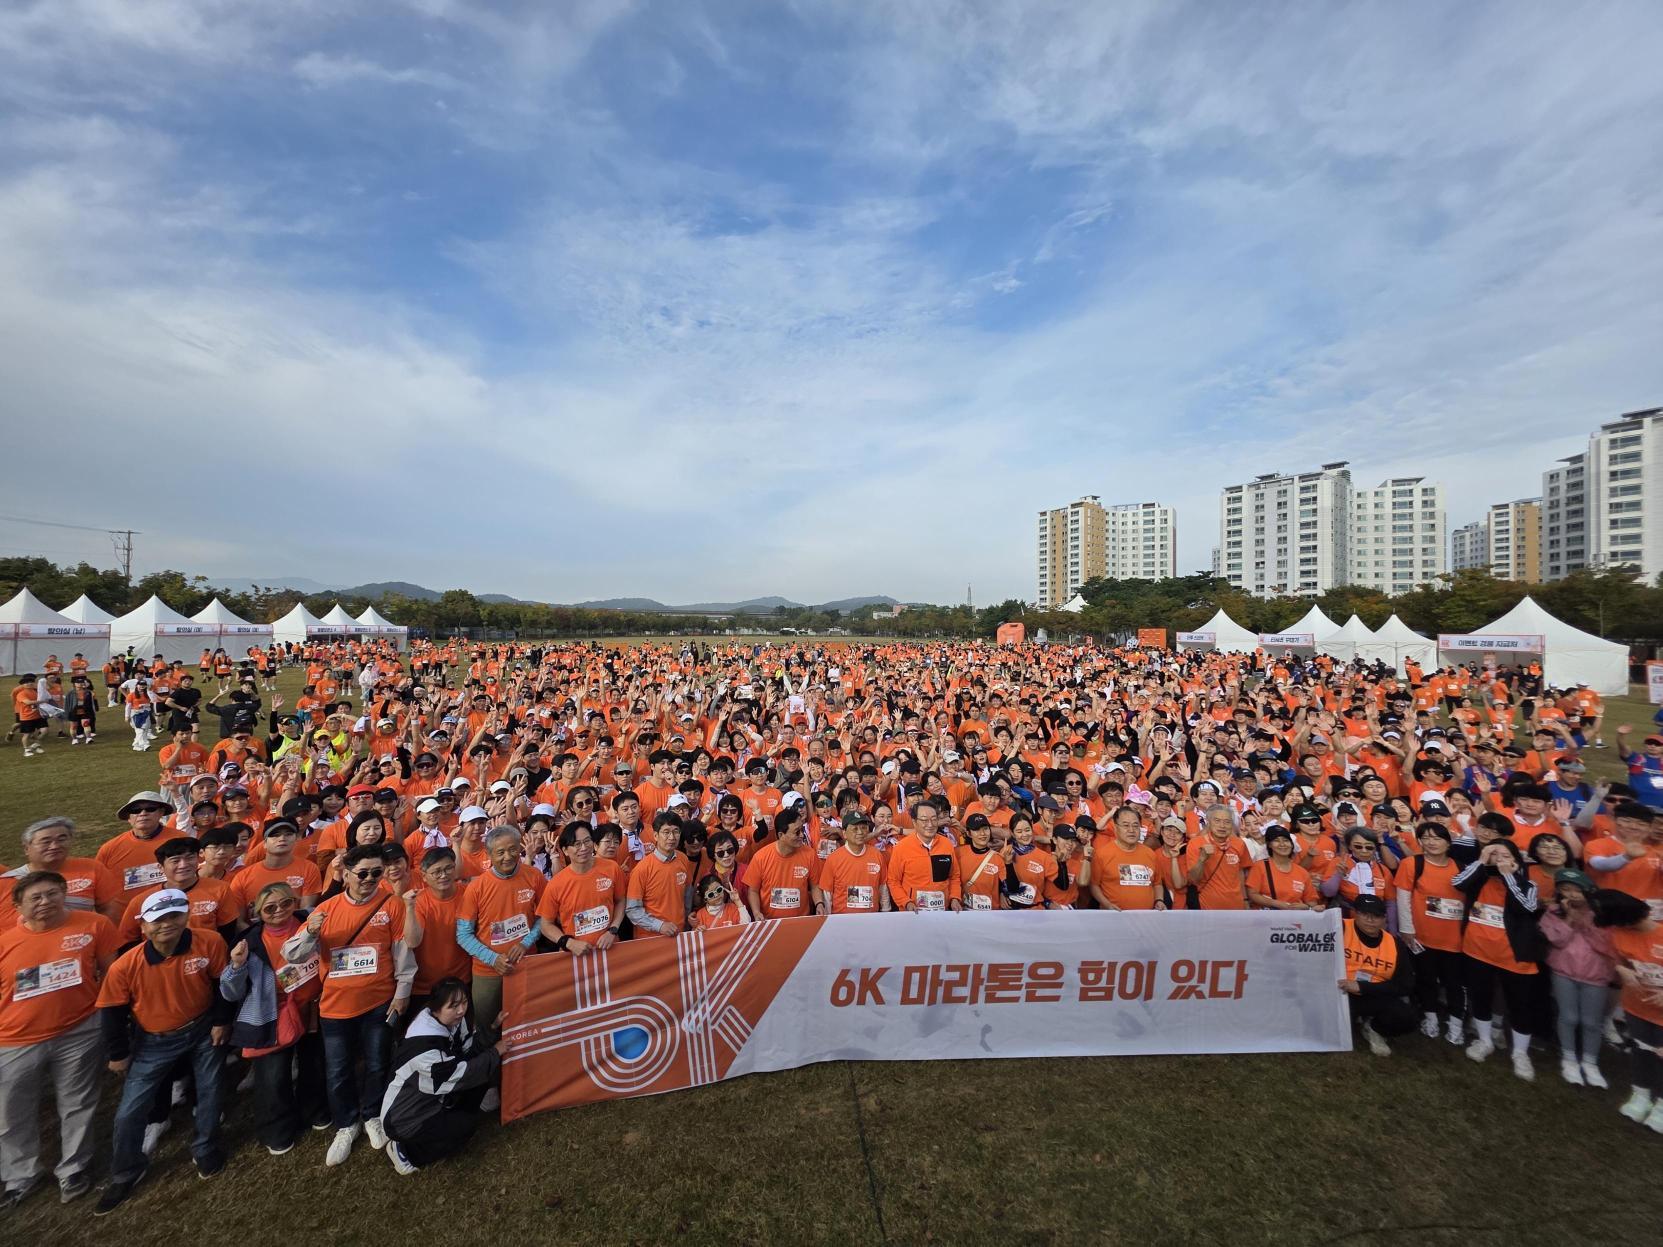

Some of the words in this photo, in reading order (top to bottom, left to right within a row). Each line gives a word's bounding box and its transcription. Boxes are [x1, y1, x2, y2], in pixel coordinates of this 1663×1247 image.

[506, 921, 527, 935] 0006
[1270, 933, 1321, 944] GLOBAL
[1298, 943, 1335, 952] WATER
[354, 958, 374, 968] 6614
[1344, 948, 1393, 972] STAFF
[829, 966, 893, 1007] 6K
[899, 961, 1065, 1007] 마라톤은
[1077, 960, 1158, 1002] 힘이
[1167, 959, 1249, 1000] 있다
[511, 1028, 539, 1041] KOREA
